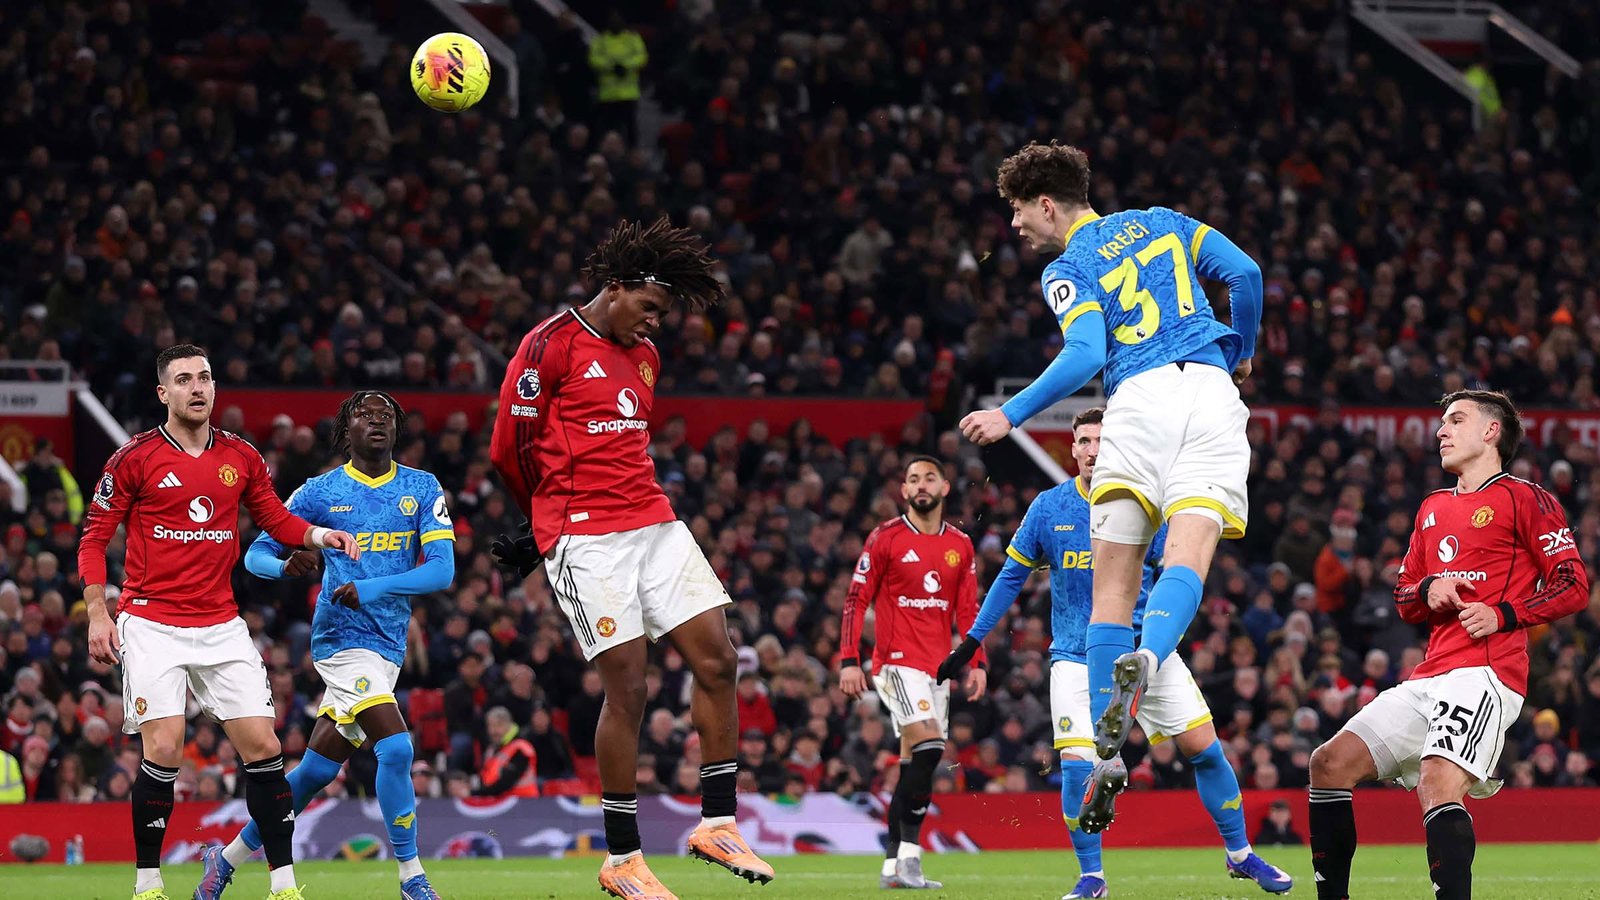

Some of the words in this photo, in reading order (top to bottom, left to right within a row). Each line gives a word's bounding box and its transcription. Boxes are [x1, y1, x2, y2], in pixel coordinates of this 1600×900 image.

[1097, 219, 1150, 260] KREJČÍ
[1053, 283, 1070, 310] JD
[1098, 232, 1196, 345] 37
[511, 404, 521, 412] No
[587, 419, 649, 434] Snapdrag
[329, 505, 353, 513] SUDU
[153, 525, 233, 544] Snapdragon
[355, 530, 416, 552] EBET
[898, 595, 949, 611] Snapdrag
[1428, 701, 1474, 736] 25
